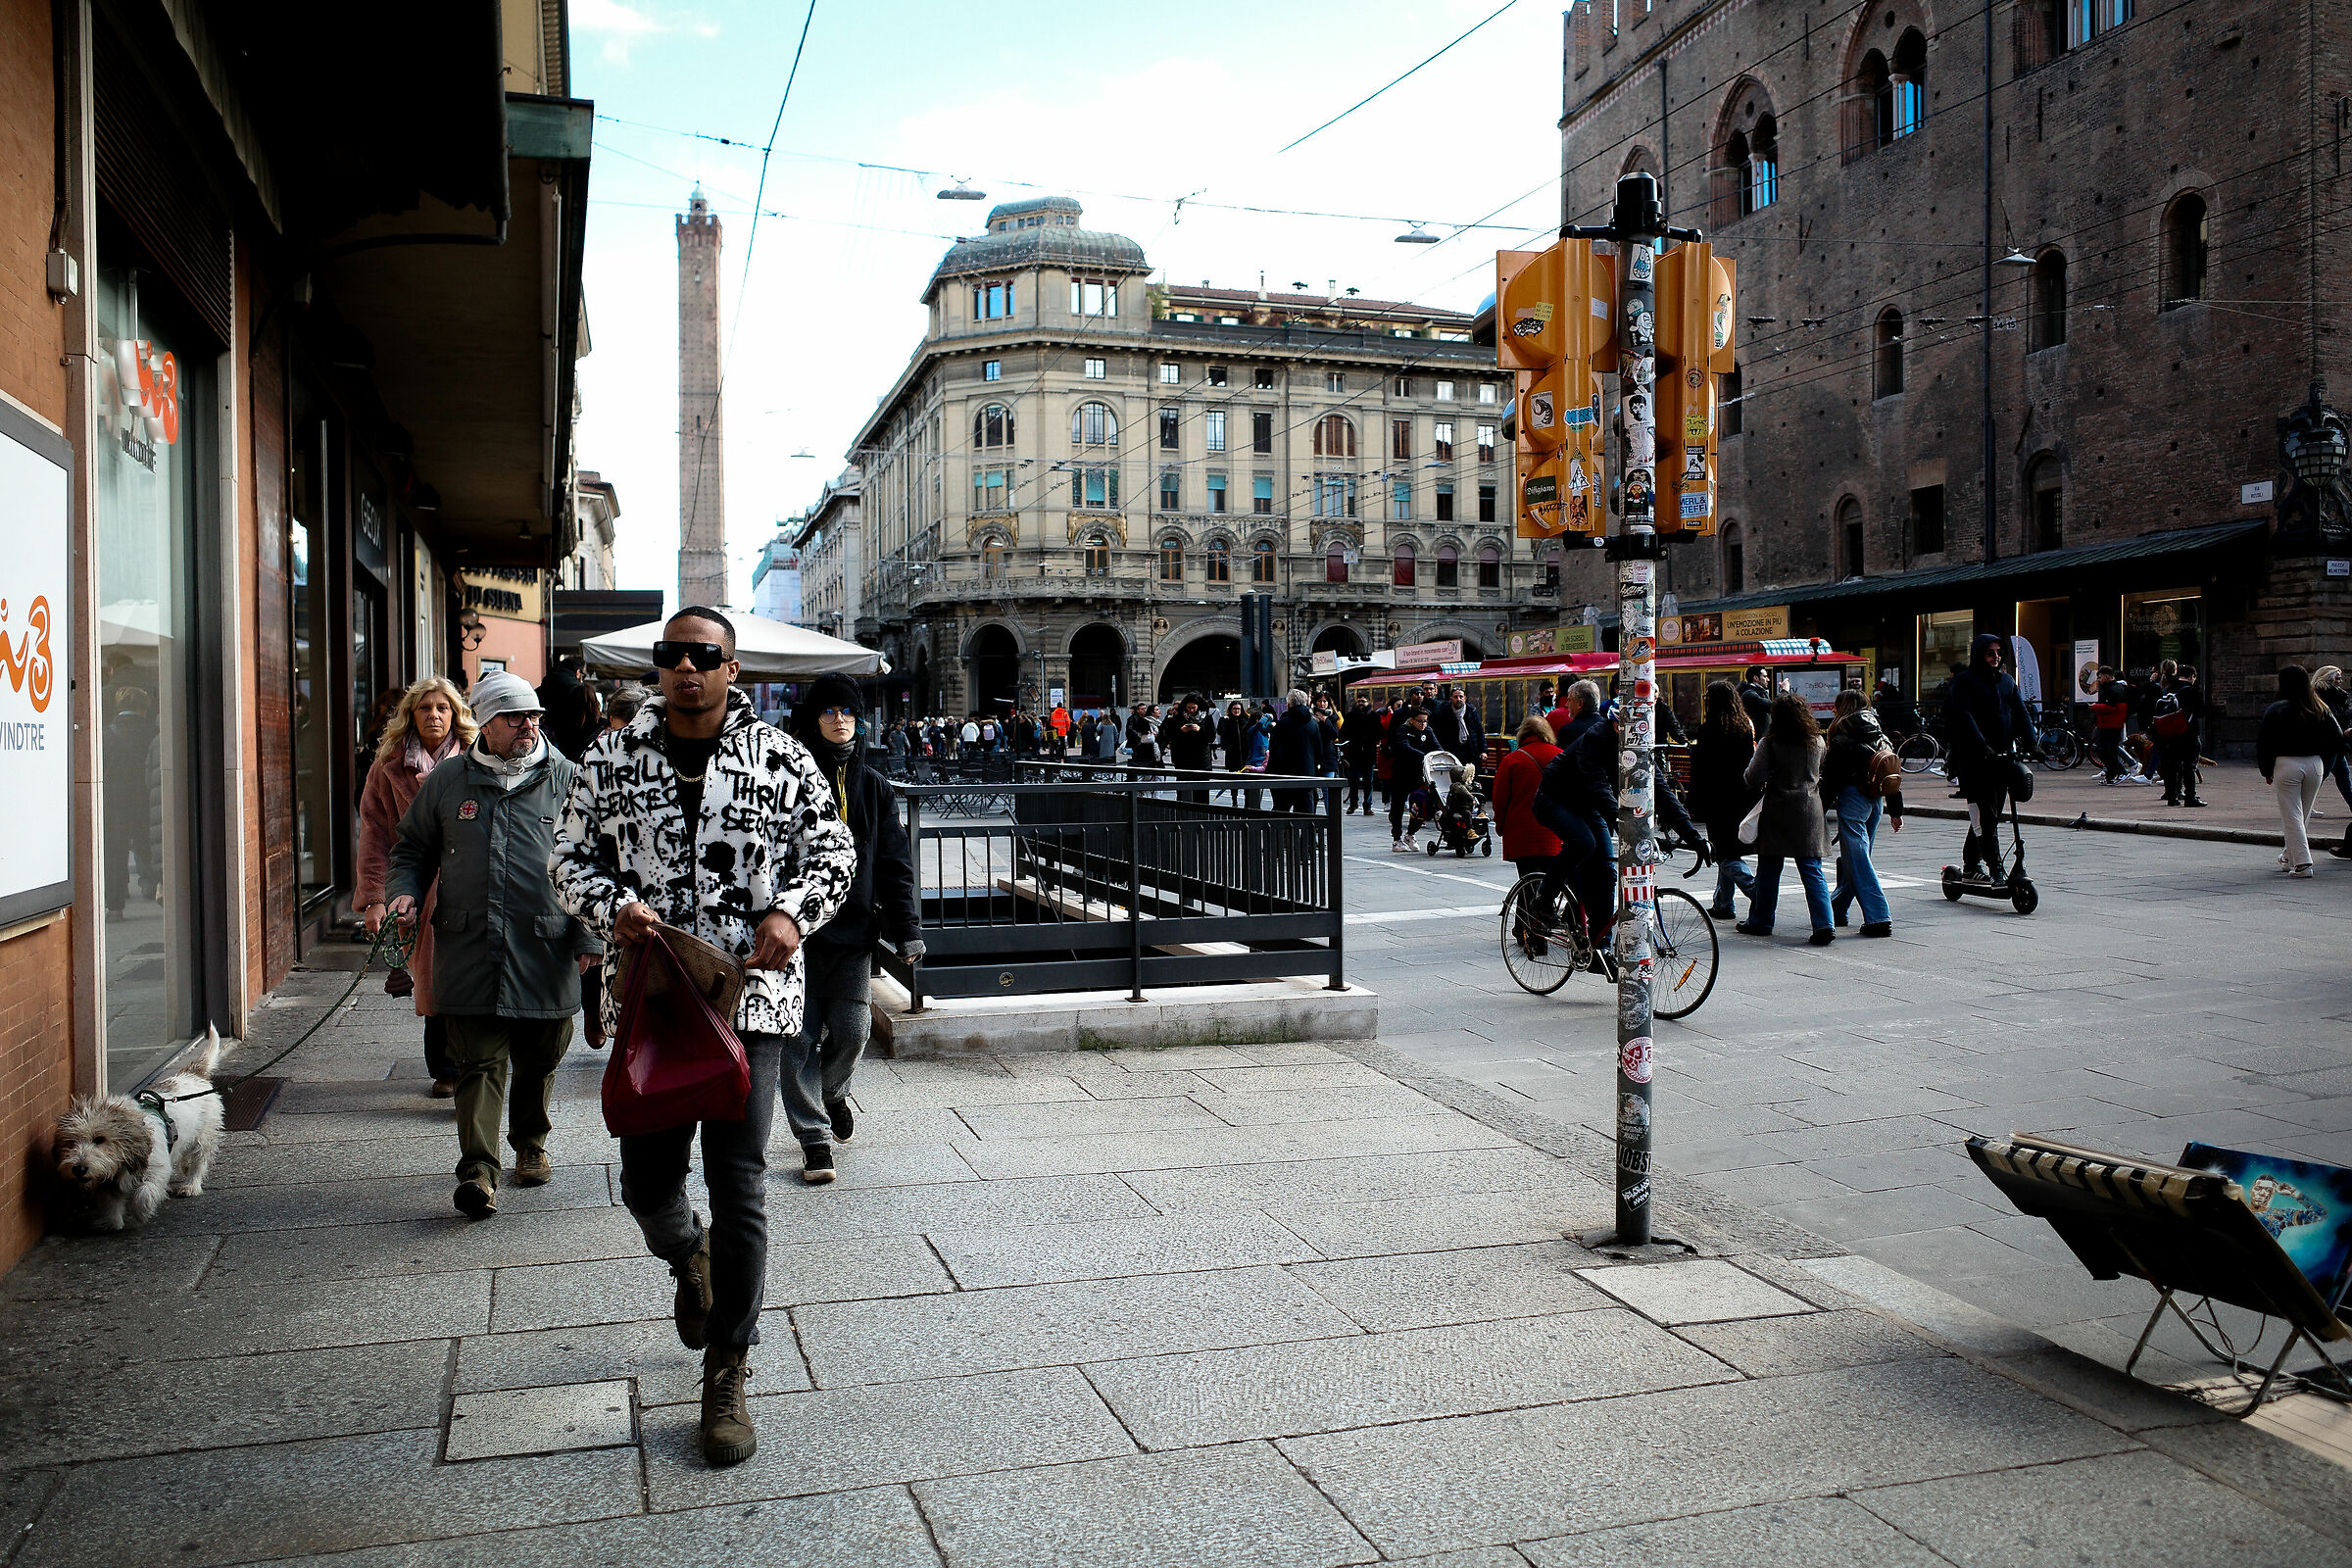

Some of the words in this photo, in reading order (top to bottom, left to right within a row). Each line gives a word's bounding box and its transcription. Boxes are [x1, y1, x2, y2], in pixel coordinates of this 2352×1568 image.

[1680, 504, 1708, 514] STEFFI
[361, 492, 382, 551] GEOX
[487, 588, 522, 611] SIENA
[1773, 615, 1782, 625] PIÙ
[1741, 627, 1773, 637] COLAZIONE
[0, 722, 45, 751] INDTRE
[588, 754, 675, 791] THRILL
